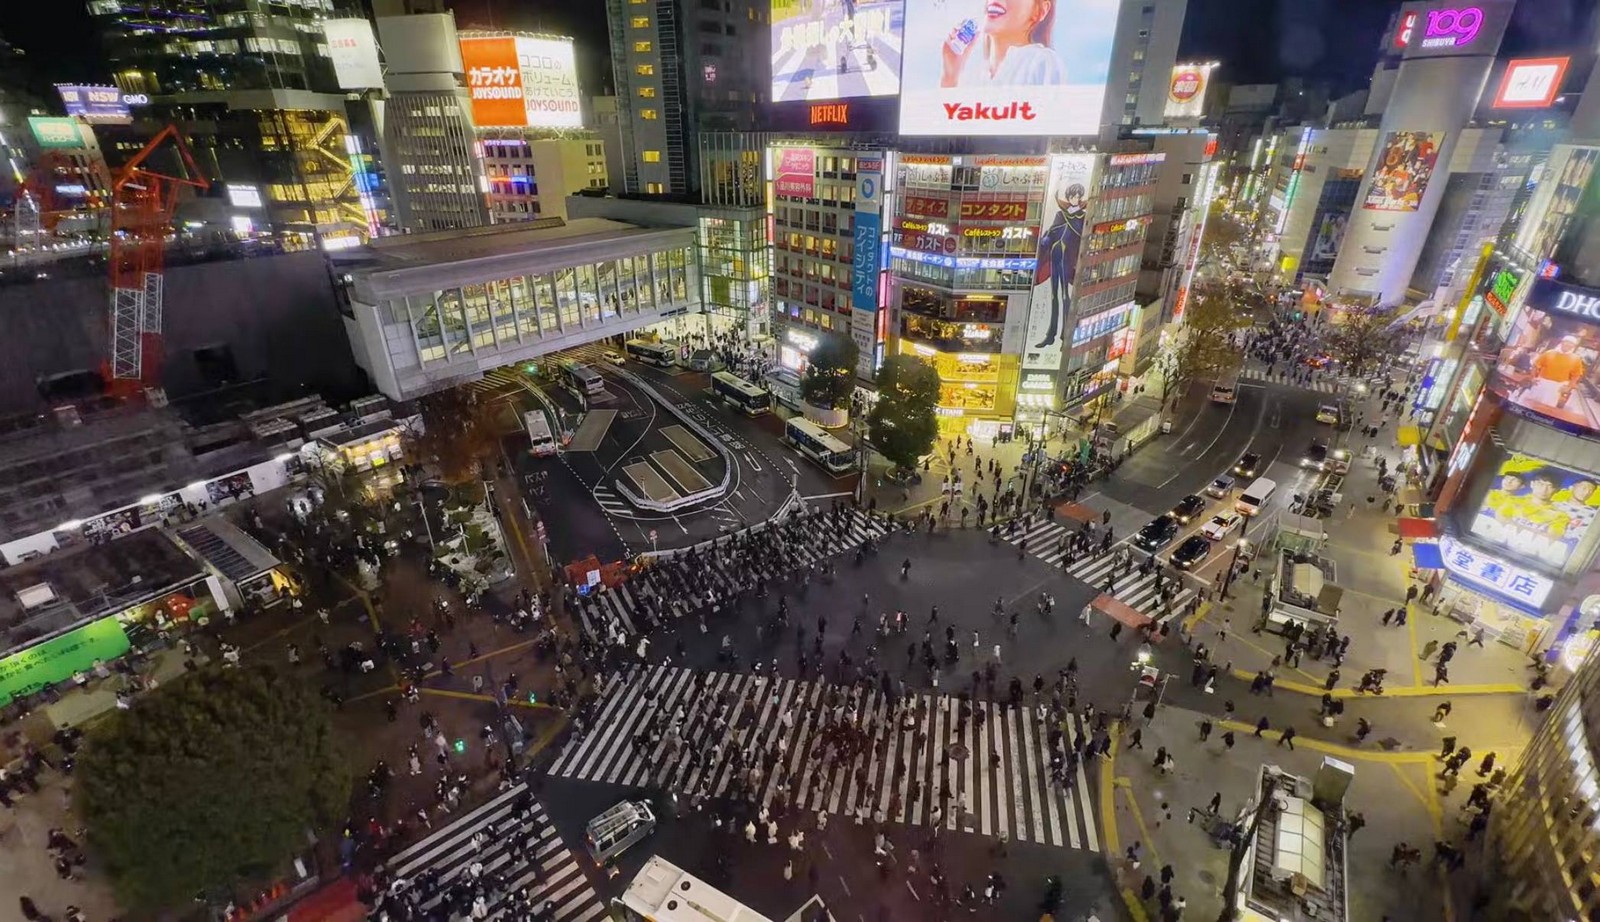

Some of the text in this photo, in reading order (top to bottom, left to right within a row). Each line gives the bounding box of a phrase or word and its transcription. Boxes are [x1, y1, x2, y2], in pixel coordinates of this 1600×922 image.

[1425, 7, 1485, 45] 109
[1421, 37, 1456, 48] SHIBUYA
[469, 66, 518, 85] カラオケ
[123, 94, 148, 104] GMO
[472, 86, 522, 99] JOYSOUND
[526, 100, 579, 112] JOYSOUND
[943, 101, 1037, 121] Yakult
[810, 104, 848, 124] NETFLIX
[961, 204, 1024, 217] コンタクト
[927, 222, 949, 236] ガスト
[1002, 226, 1033, 239] ガスト
[915, 235, 941, 251] ガスト
[856, 225, 867, 295] アイシティ
[865, 227, 876, 297] コンタクトの
